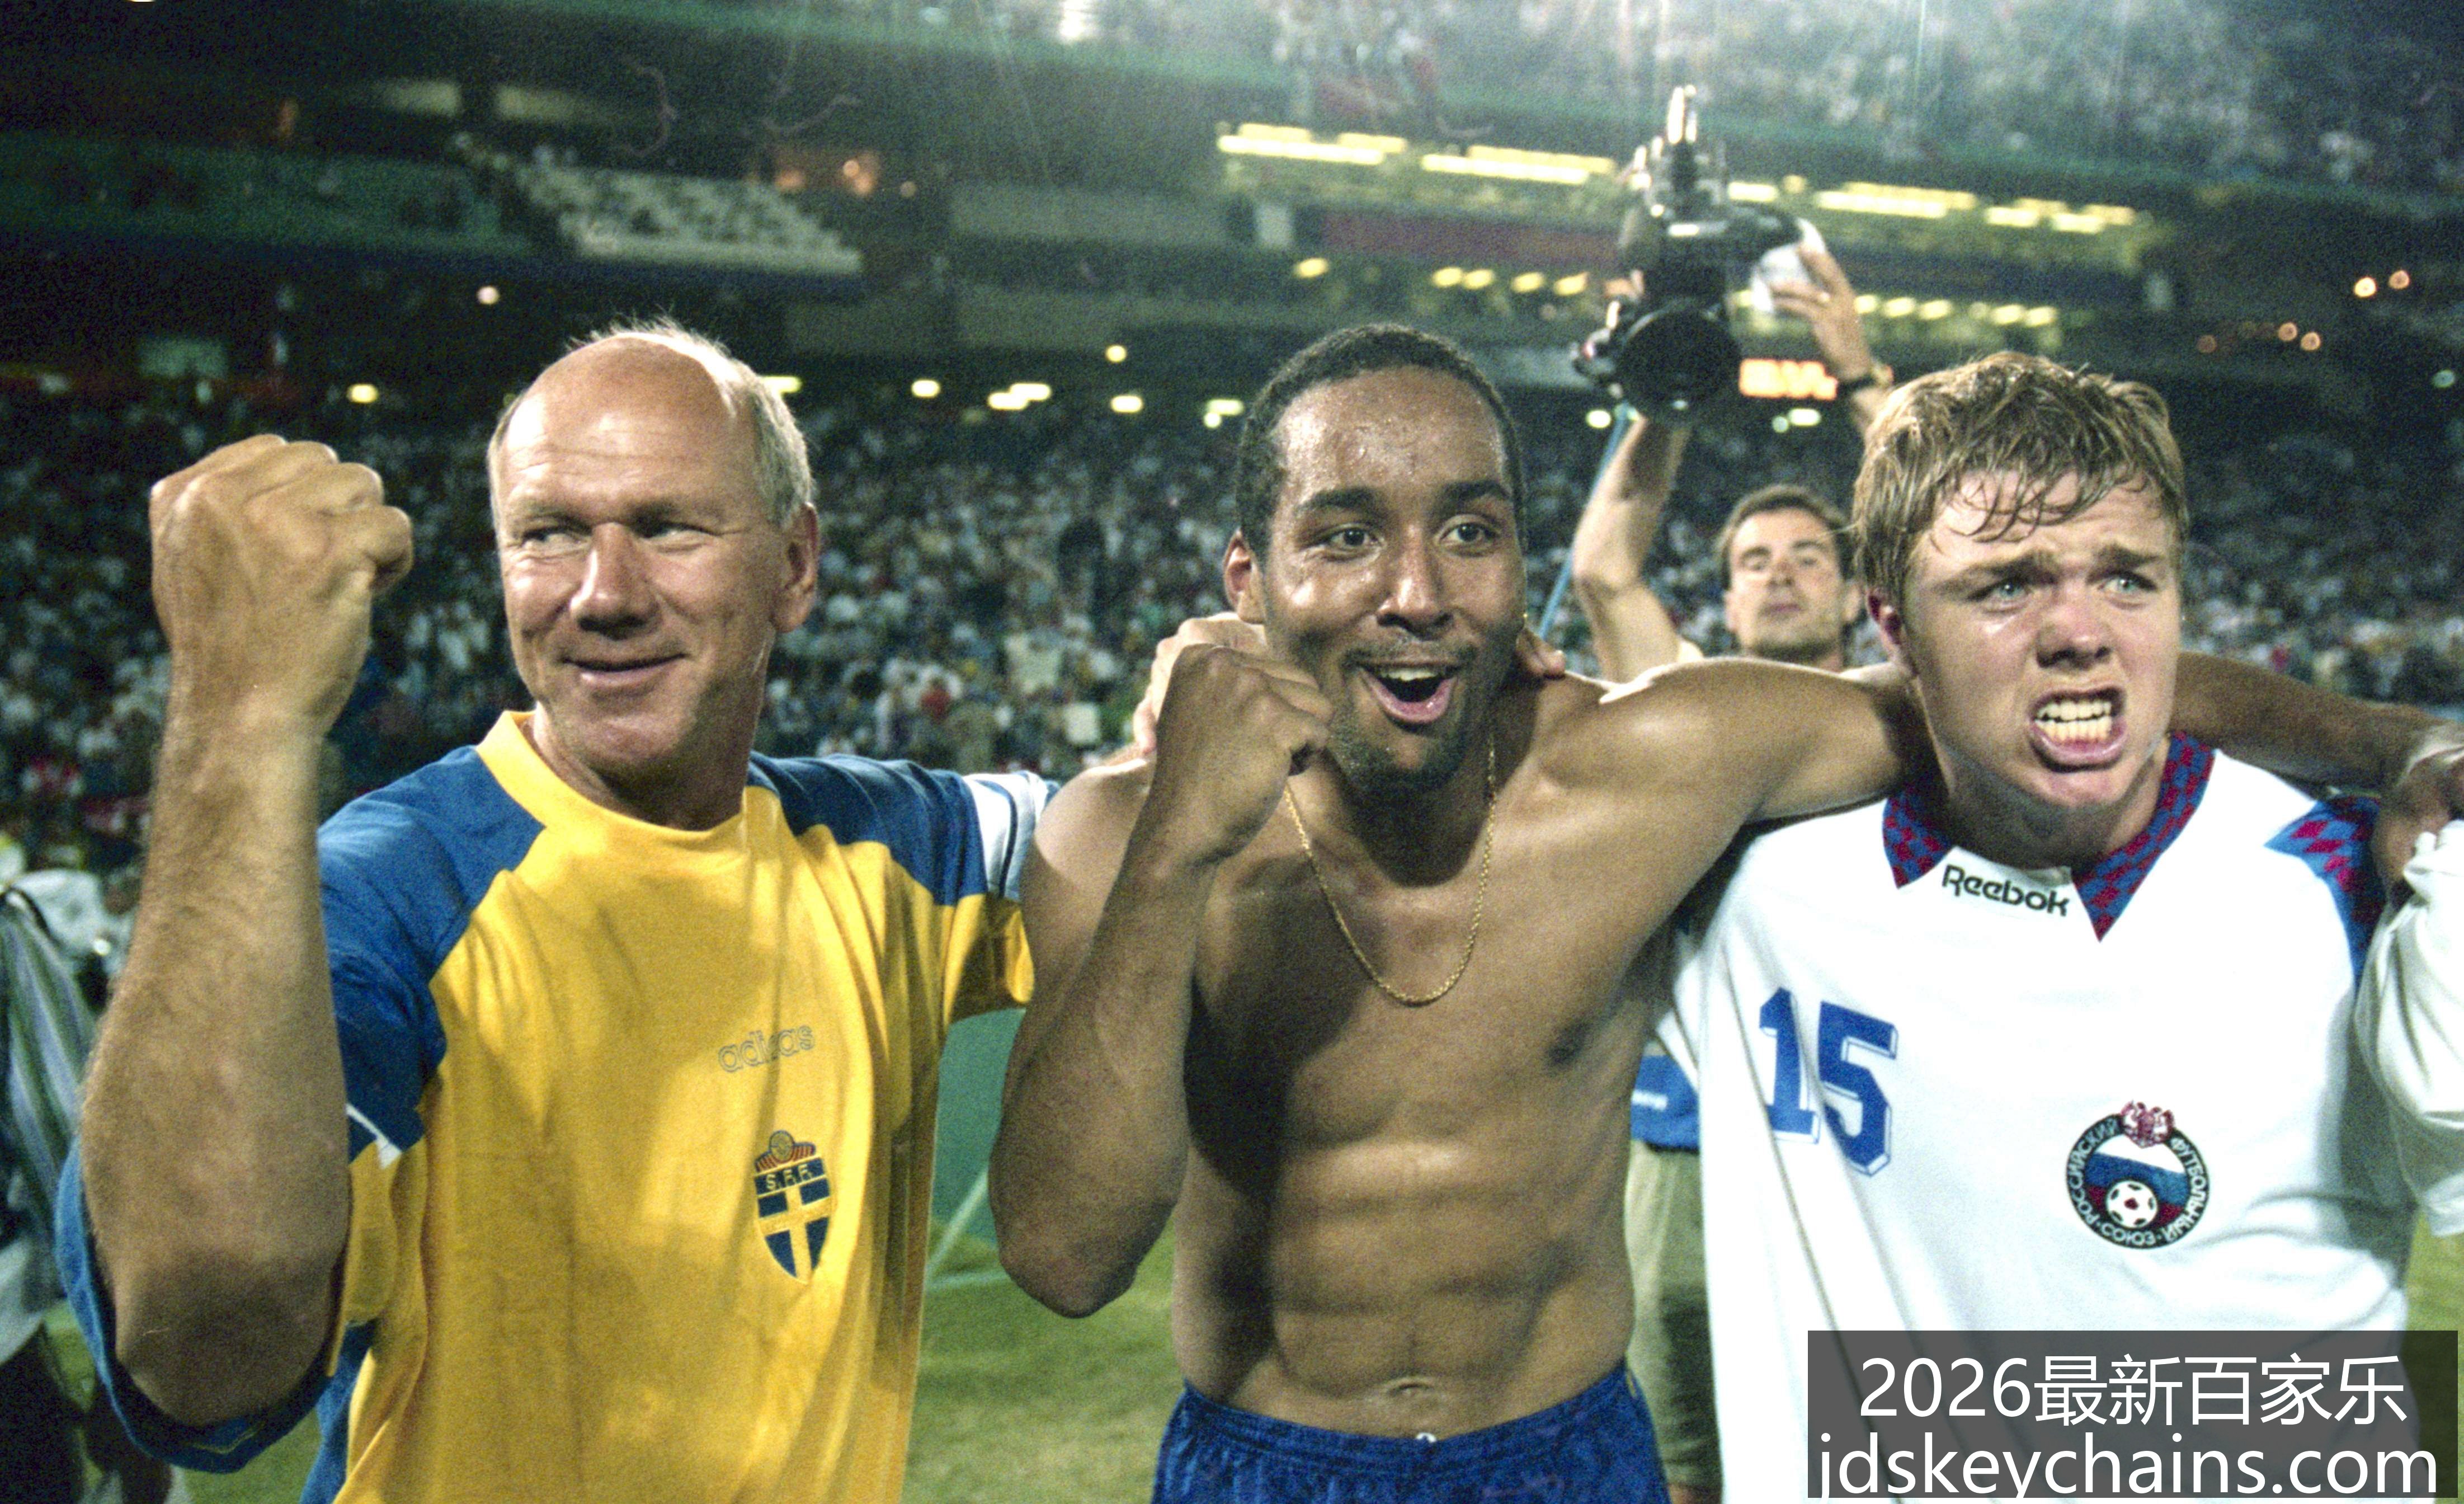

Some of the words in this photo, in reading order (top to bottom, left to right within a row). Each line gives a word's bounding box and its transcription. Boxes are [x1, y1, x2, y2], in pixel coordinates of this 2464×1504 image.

[1942, 863, 2069, 916] Reebok
[1759, 987, 1898, 1177] 15
[2069, 1116, 2118, 1224] РОССИЙСКИЙ
[2161, 1137, 2207, 1243] ФУТБОЛЬНЫЙ
[2102, 1223, 2156, 1246] СОЮЗ
